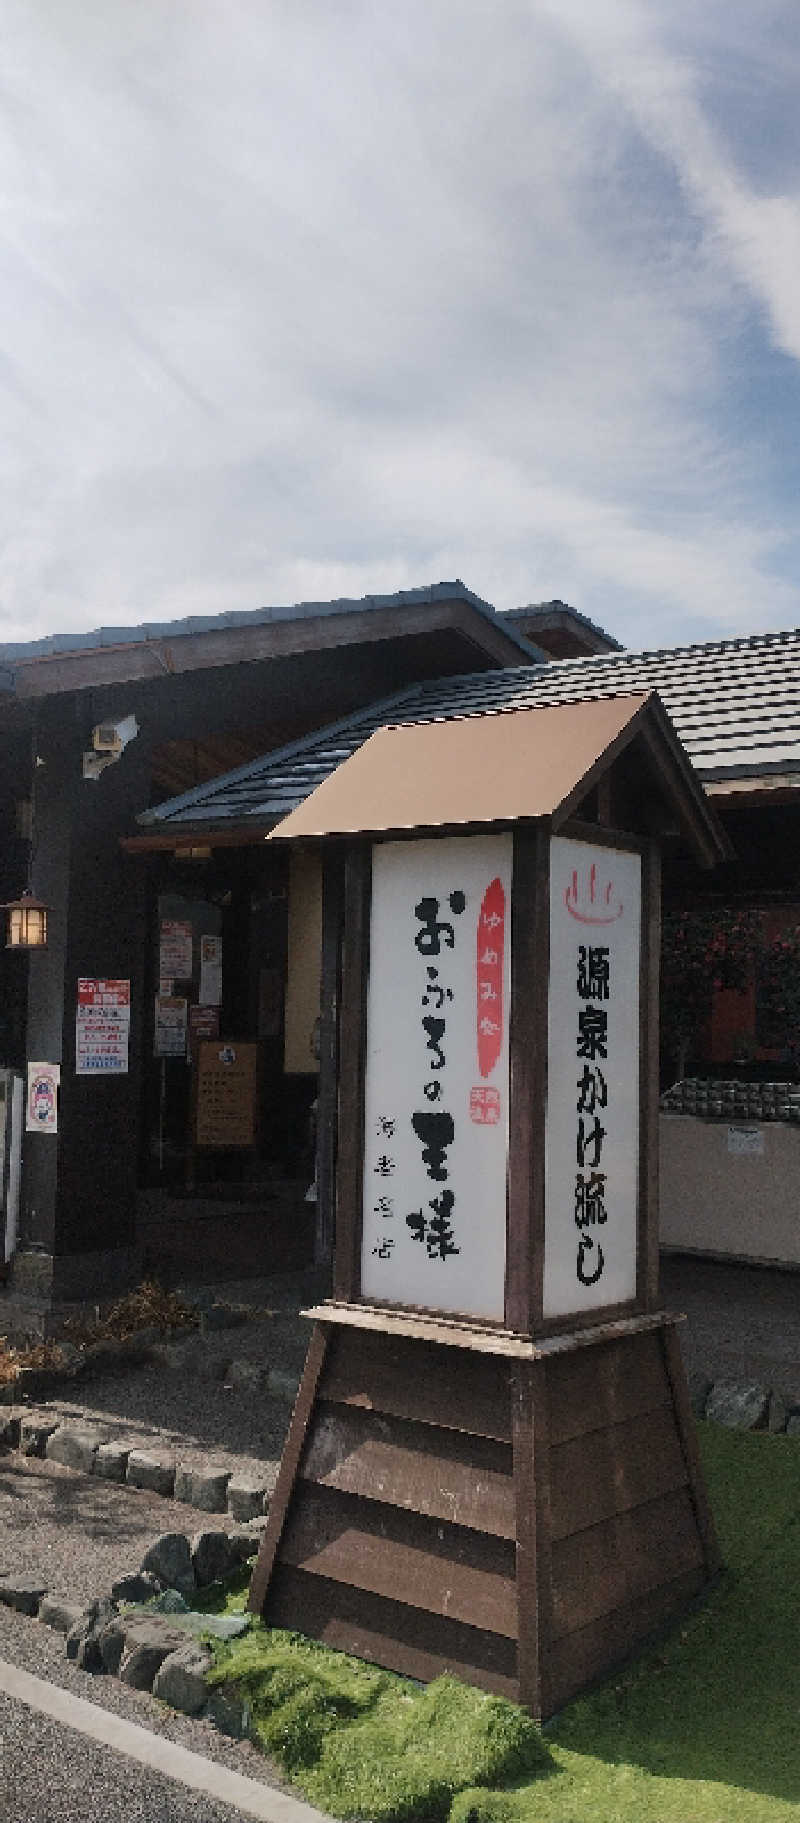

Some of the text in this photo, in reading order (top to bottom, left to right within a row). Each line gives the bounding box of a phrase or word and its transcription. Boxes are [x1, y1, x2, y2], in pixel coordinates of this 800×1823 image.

[406, 890, 465, 1261] おふろの王様
[575, 945, 610, 1287] 源泉かけ流し
